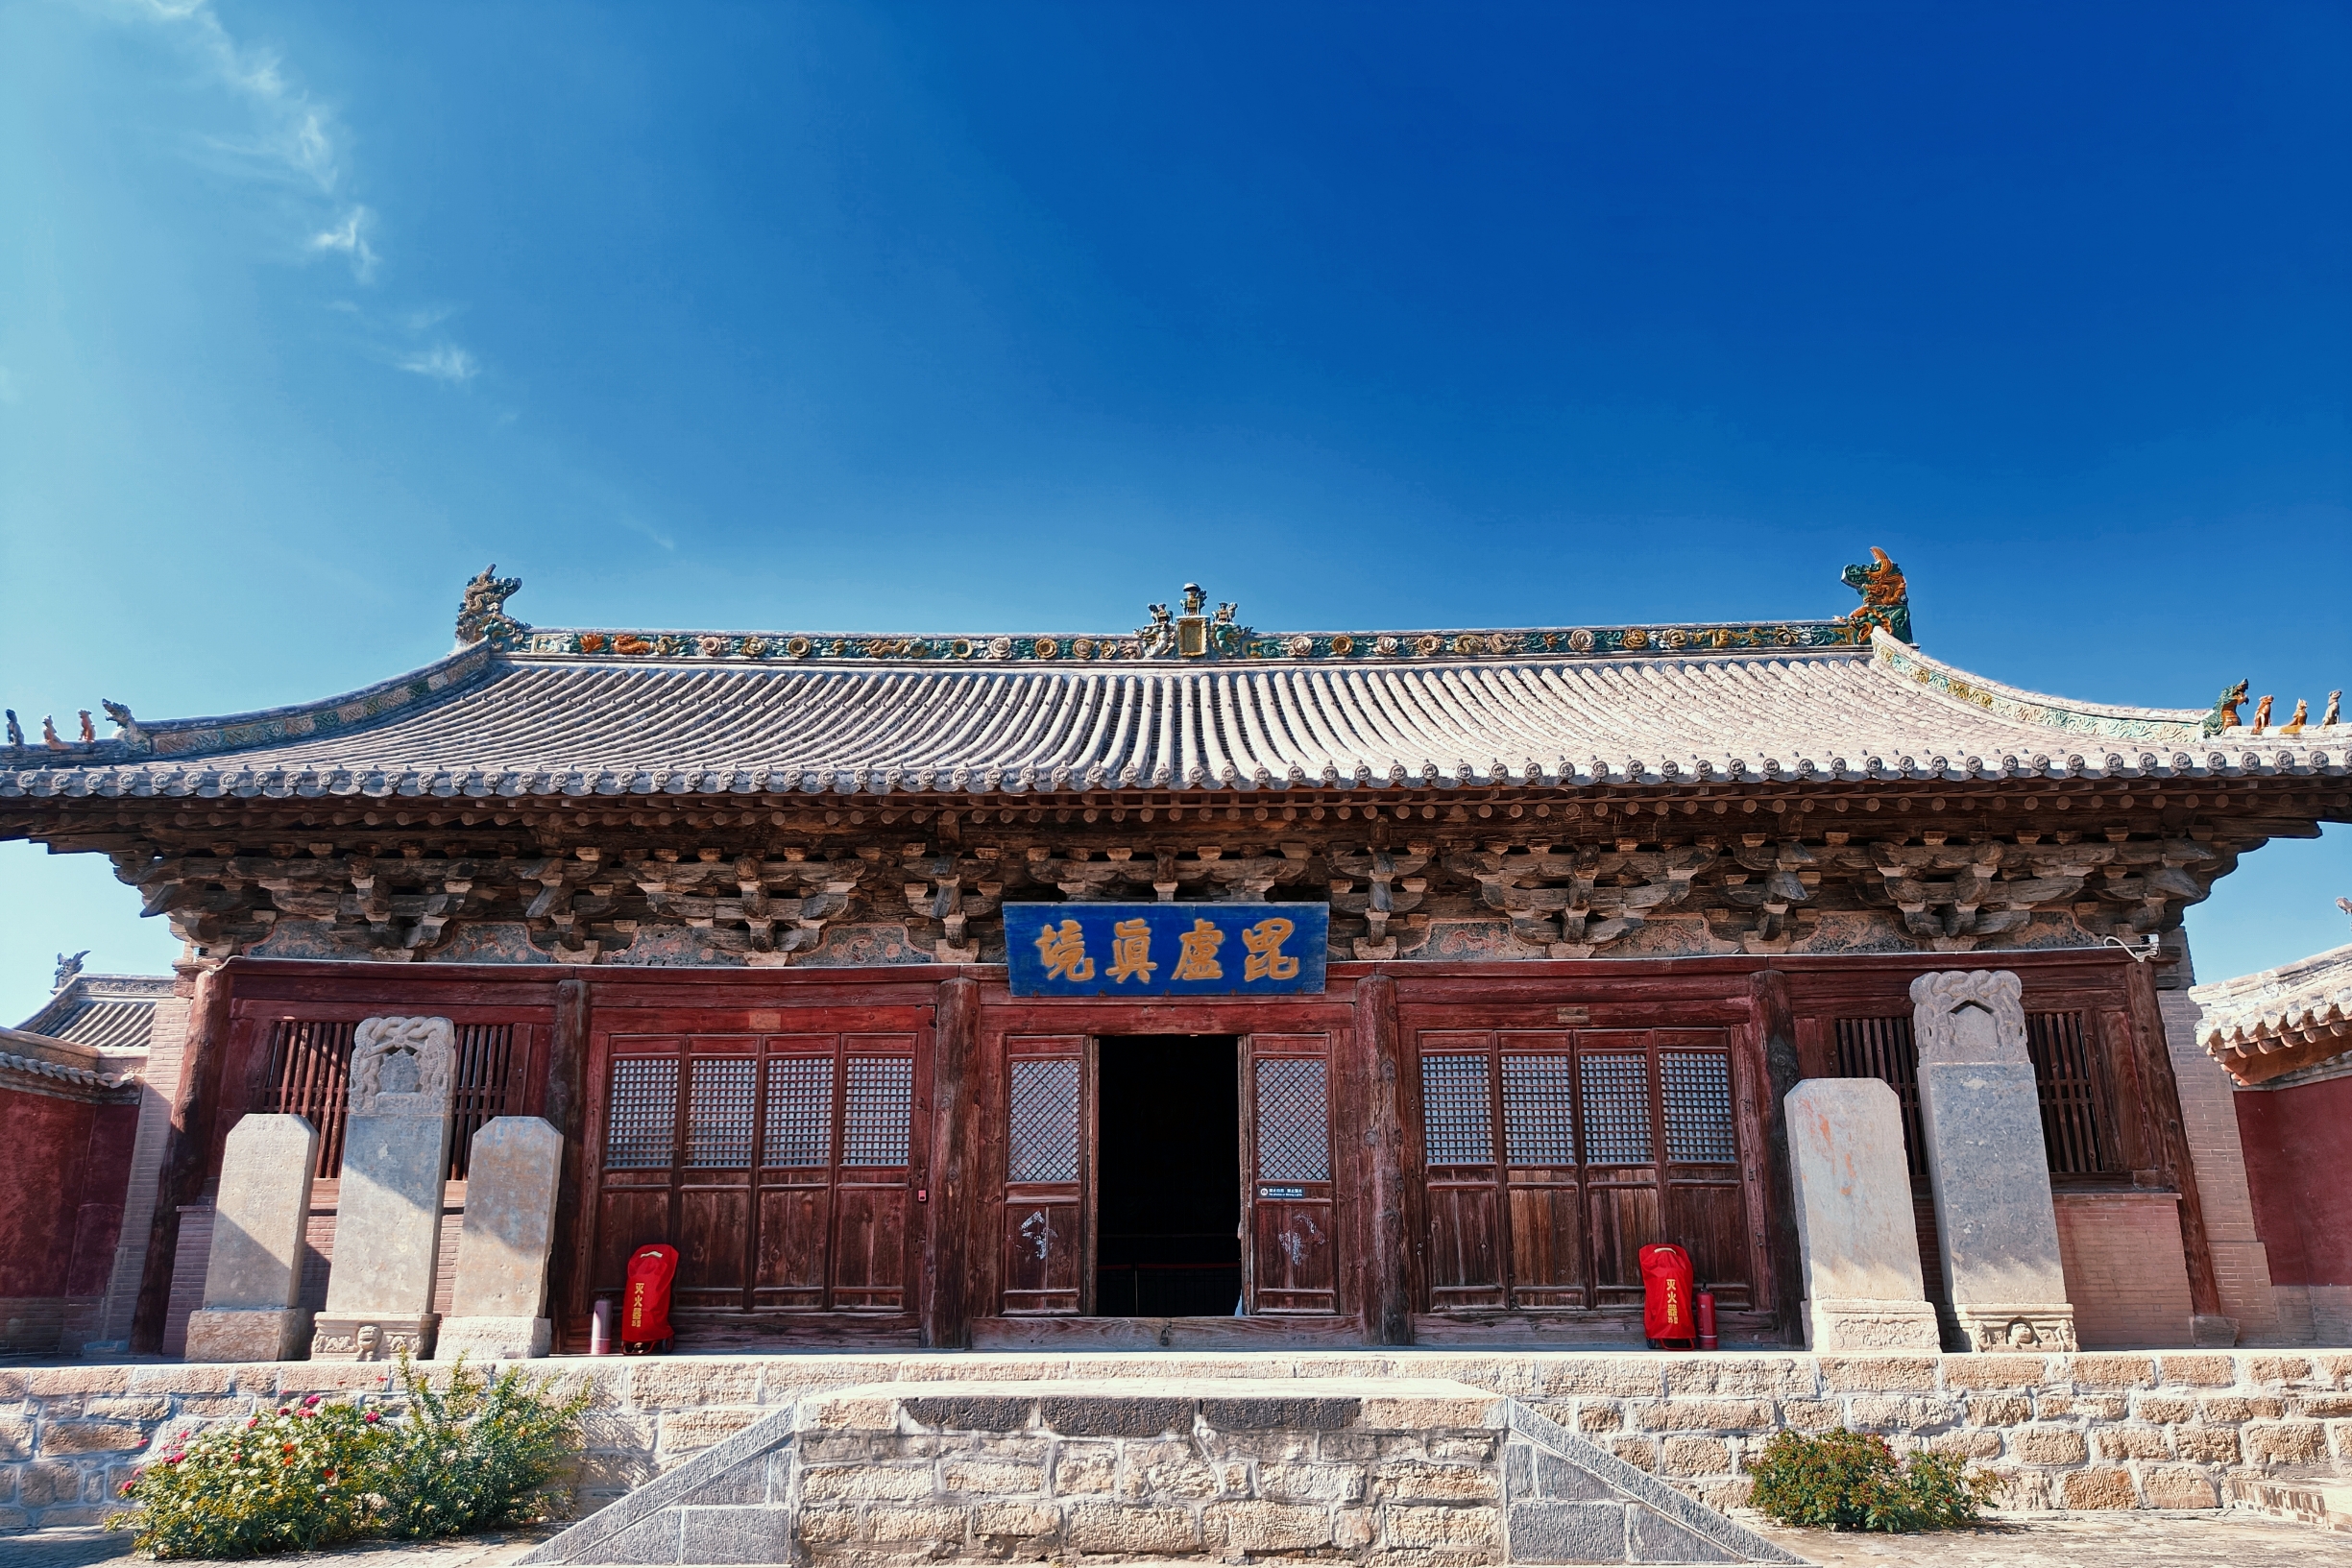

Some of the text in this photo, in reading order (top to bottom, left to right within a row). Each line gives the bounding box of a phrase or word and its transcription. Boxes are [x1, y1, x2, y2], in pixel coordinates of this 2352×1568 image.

[632, 1282, 645, 1320] 灭火器
[1665, 1278, 1678, 1316] 灭火器
